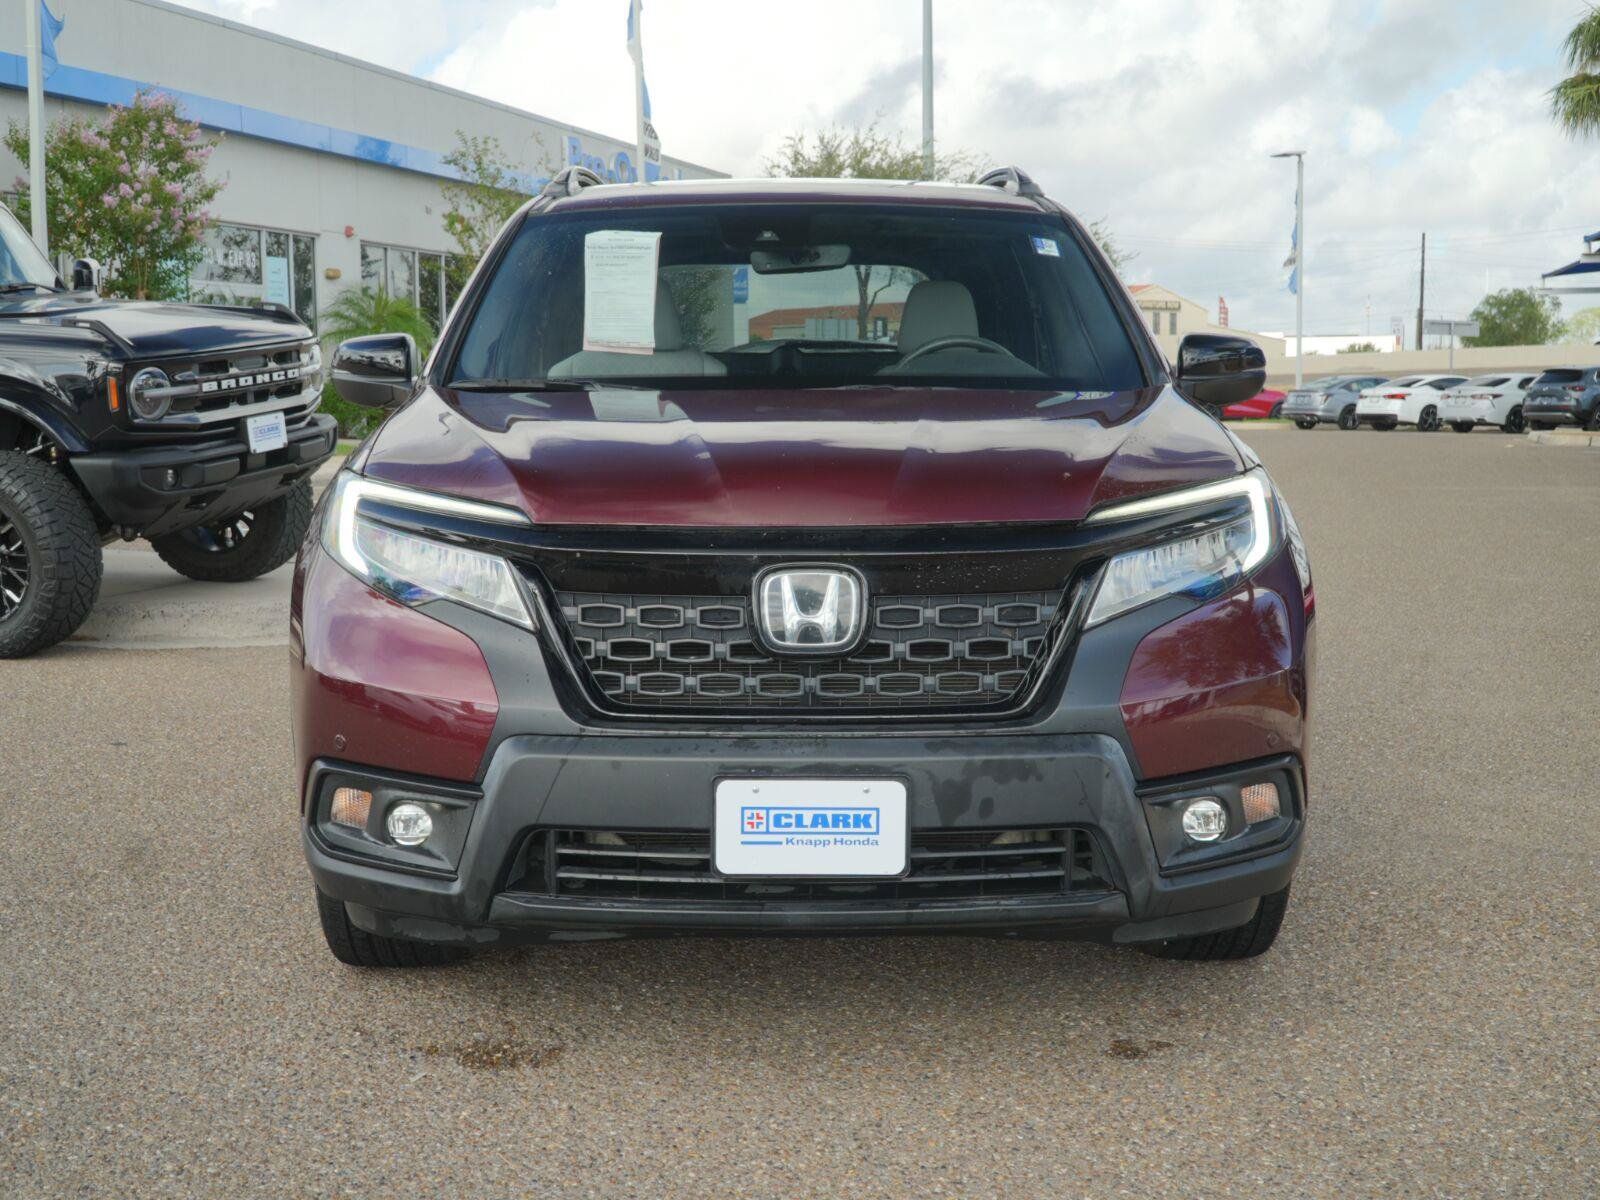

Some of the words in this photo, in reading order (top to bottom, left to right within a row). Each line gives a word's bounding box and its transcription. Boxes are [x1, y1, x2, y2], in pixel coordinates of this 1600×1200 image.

[202, 368, 300, 392] BRONCO
[773, 813, 873, 829] CLARK
[785, 837, 831, 848] Knapp
[833, 837, 879, 846] Honda
